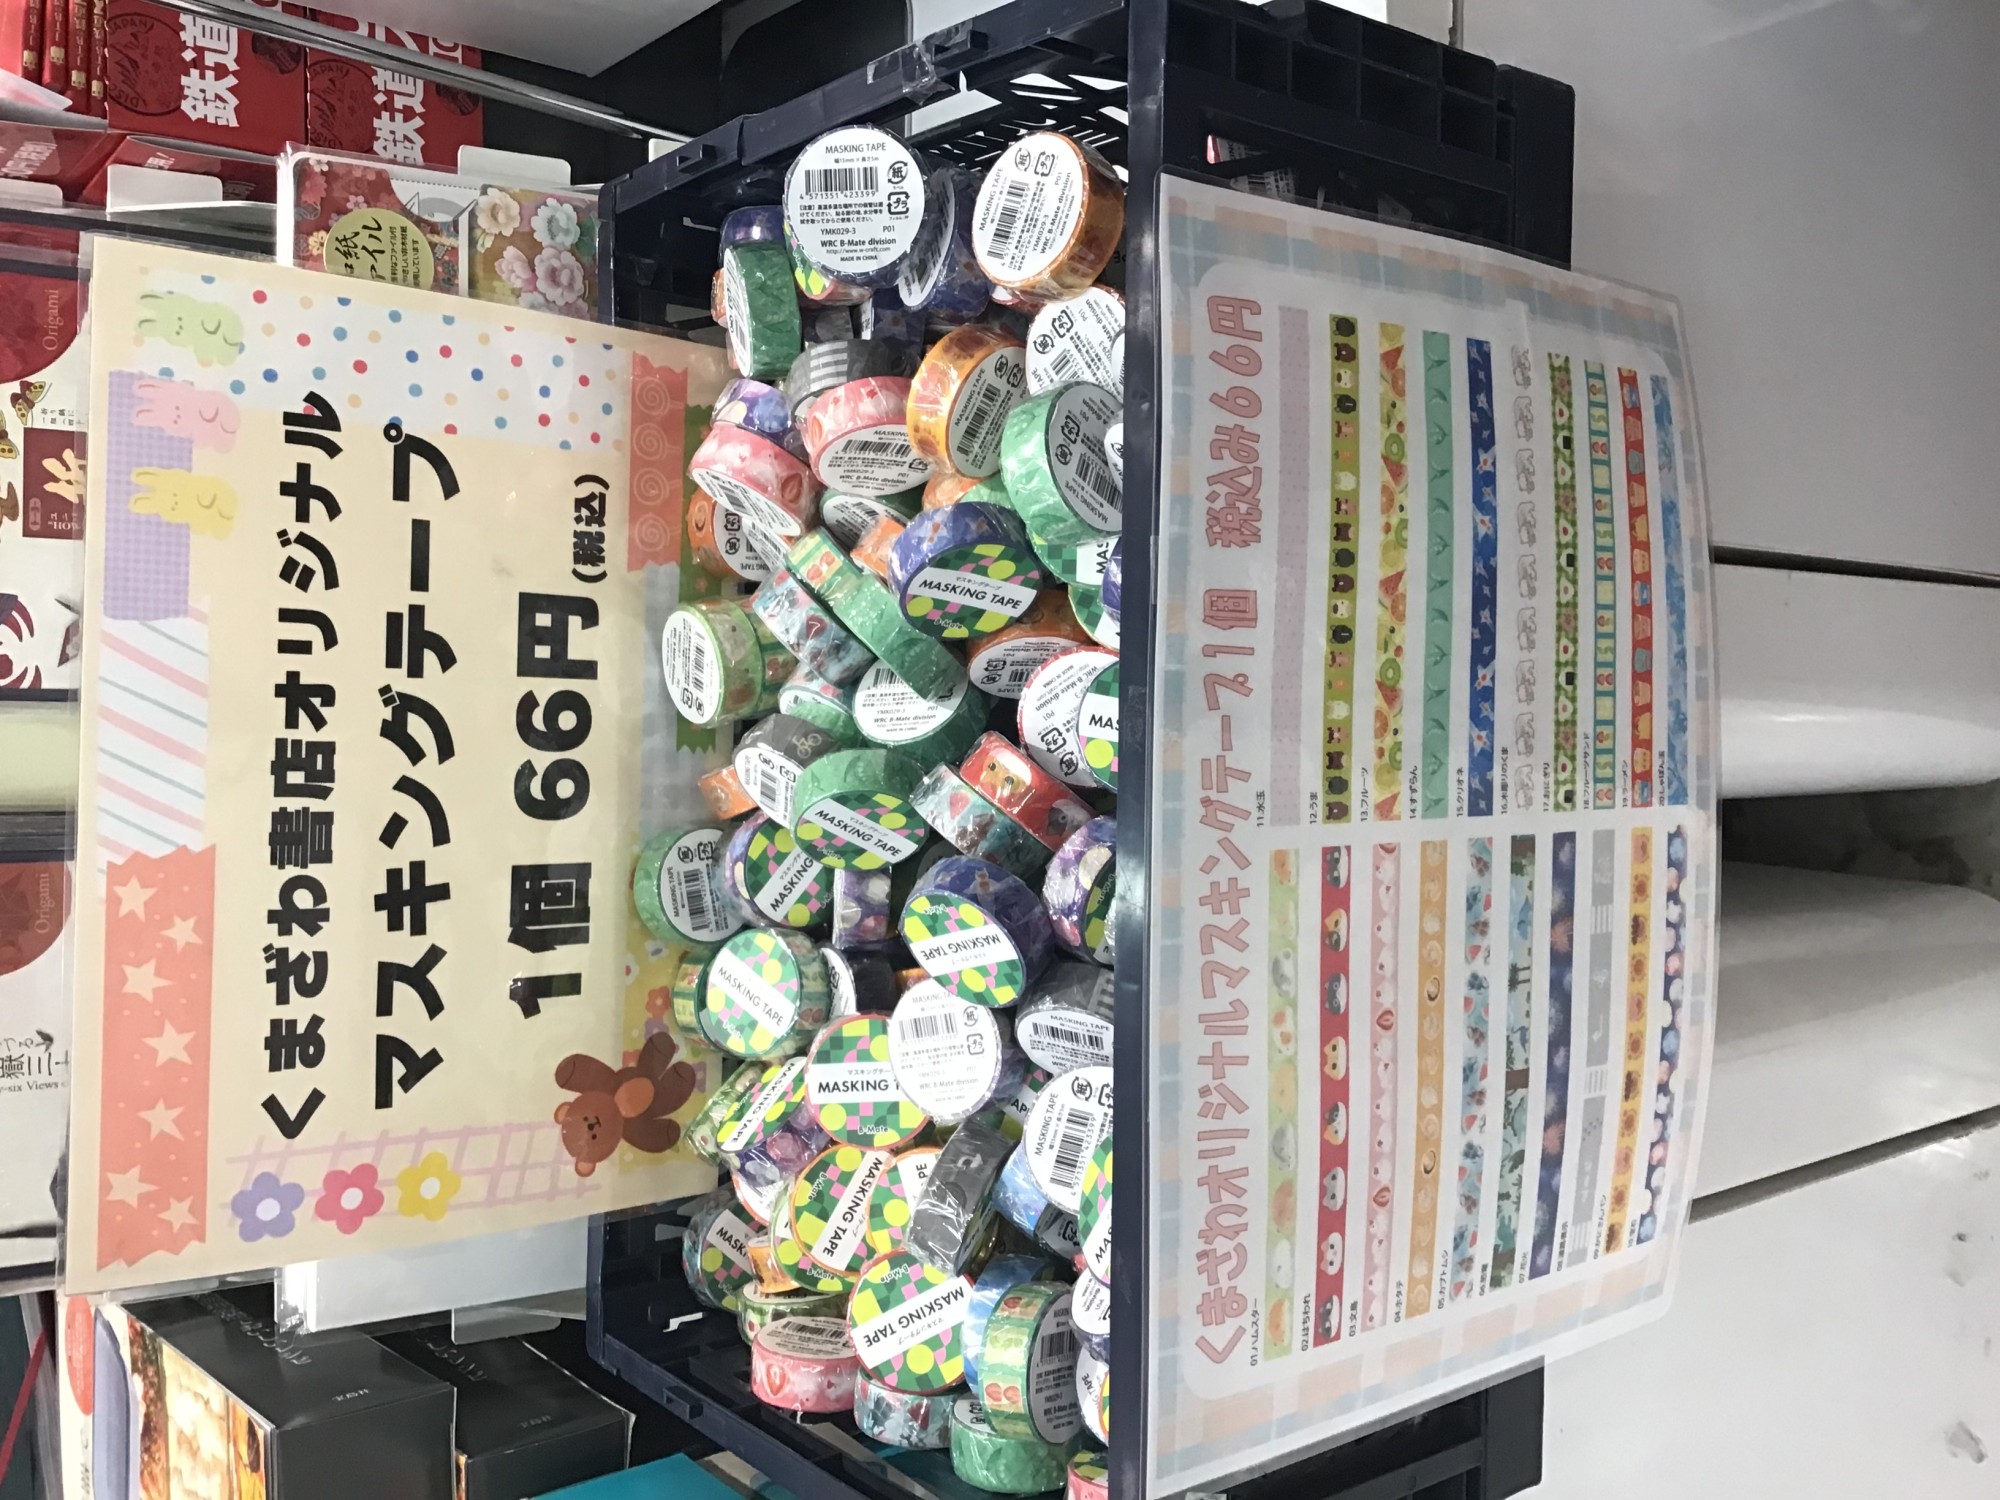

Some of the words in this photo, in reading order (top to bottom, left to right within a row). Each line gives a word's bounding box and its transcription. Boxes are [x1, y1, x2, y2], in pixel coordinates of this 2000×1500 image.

[178, 12, 240, 127] 鉄道
[825, 144, 864, 154] MASKING
[866, 143, 886, 151] TAPE
[1017, 153, 1028, 166] 紙
[892, 166, 903, 179] 紙
[1054, 171, 1063, 186] P01
[844, 190, 876, 198] 423399
[894, 197, 908, 209] プラ
[979, 190, 997, 231] MASKING
[991, 167, 1003, 189] TAPE
[1040, 236, 1051, 254] WRC
[1046, 205, 1061, 234] B-Mate
[1057, 172, 1071, 203] division
[1059, 220, 1067, 236] MADE
[1066, 195, 1075, 212] CHINA
[820, 227, 856, 235] YMK029-3
[820, 240, 837, 248] WRC
[839, 239, 867, 247] B-Mate
[869, 238, 896, 246] division
[1032, 214, 1049, 251] YMK029-3
[42, 289, 62, 350] Origami
[1079, 308, 1088, 321] P01
[1085, 299, 1103, 323] division
[1031, 367, 1046, 387] TAPE
[954, 390, 976, 427] MASKING
[972, 368, 986, 388] TAPE
[1204, 295, 1263, 548] 税込み66円
[1064, 480, 1080, 496] TAPE
[1079, 495, 1108, 524] MASKING
[572, 474, 610, 585] (税込)
[918, 578, 987, 600] MASKING
[990, 594, 1022, 609] TAPE
[514, 592, 599, 822] 66円
[1035, 693, 1061, 711] division
[1043, 710, 1055, 721] P01
[260, 390, 343, 1140] くまざわ書店オリジナル
[373, 422, 460, 1110] マスキングテープ
[1256, 790, 1265, 827] 11.水玉
[1310, 792, 1318, 824] 12.うま
[1360, 767, 1368, 822] 13.フルーツ
[1410, 766, 1418, 819] 14.すずらん
[1456, 767, 1464, 817] 15.クリオネ
[815, 810, 874, 841] MASKING
[874, 838, 902, 856] TAPE
[669, 885, 679, 917] MASKING
[770, 856, 814, 912] MASKING
[34, 872, 54, 934] Origami
[506, 862, 592, 1020] 1個
[920, 946, 948, 960] TAPE
[948, 934, 1001, 953] MASKING
[1194, 588, 1258, 1364] くまざわオリジナルマスキングテープ1個
[718, 966, 761, 1007] MASKING
[762, 1002, 783, 1025] TAPE
[1050, 1015, 1088, 1028] MASKING
[1090, 1023, 1109, 1031] TAPE
[752, 1062, 796, 1115] MASKING
[817, 1079, 889, 1094] MASKING
[1075, 1082, 1088, 1096] 紙
[731, 1118, 753, 1143] TAPE
[858, 1127, 889, 1135] B-Mate
[1034, 1115, 1053, 1156] MASKING
[1045, 1092, 1059, 1115] TAPE
[1072, 1154, 1087, 1187] 571351
[1080, 1115, 1096, 1151] 423399
[842, 1157, 883, 1223] MASKING
[822, 1226, 848, 1258] TAPE
[898, 1286, 965, 1328] MASKING
[863, 1324, 896, 1348] TAPE
[1250, 1298, 1260, 1366] 01.ハムスター
[1081, 1372, 1094, 1394] TAPE
